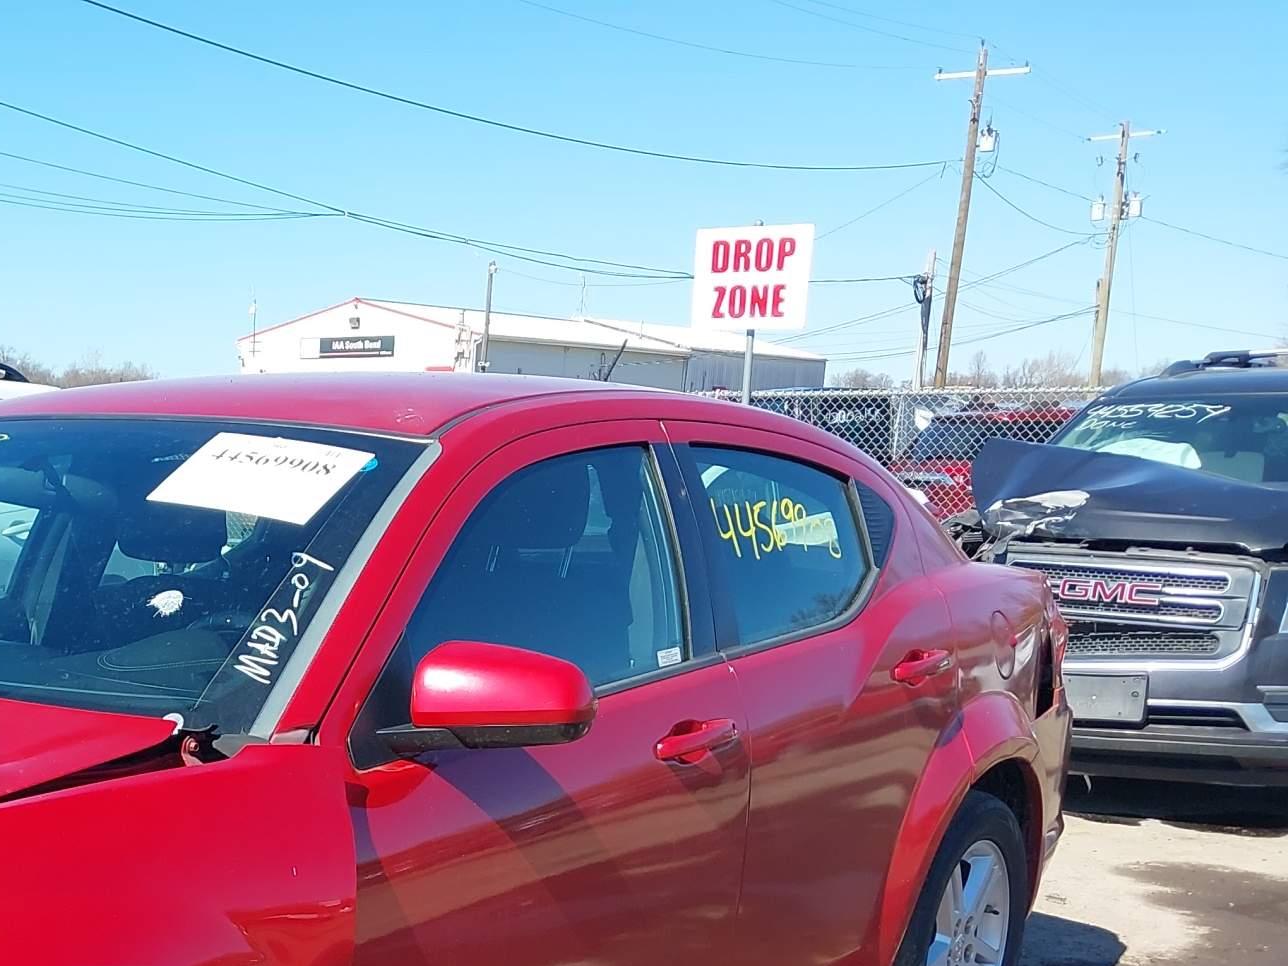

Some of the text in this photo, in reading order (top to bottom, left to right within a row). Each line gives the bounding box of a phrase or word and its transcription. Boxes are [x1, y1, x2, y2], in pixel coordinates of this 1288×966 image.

[711, 237, 797, 274] DROP
[711, 283, 787, 319] ZONE
[211, 448, 338, 476] 44569908
[1058, 578, 1162, 606] GMC
